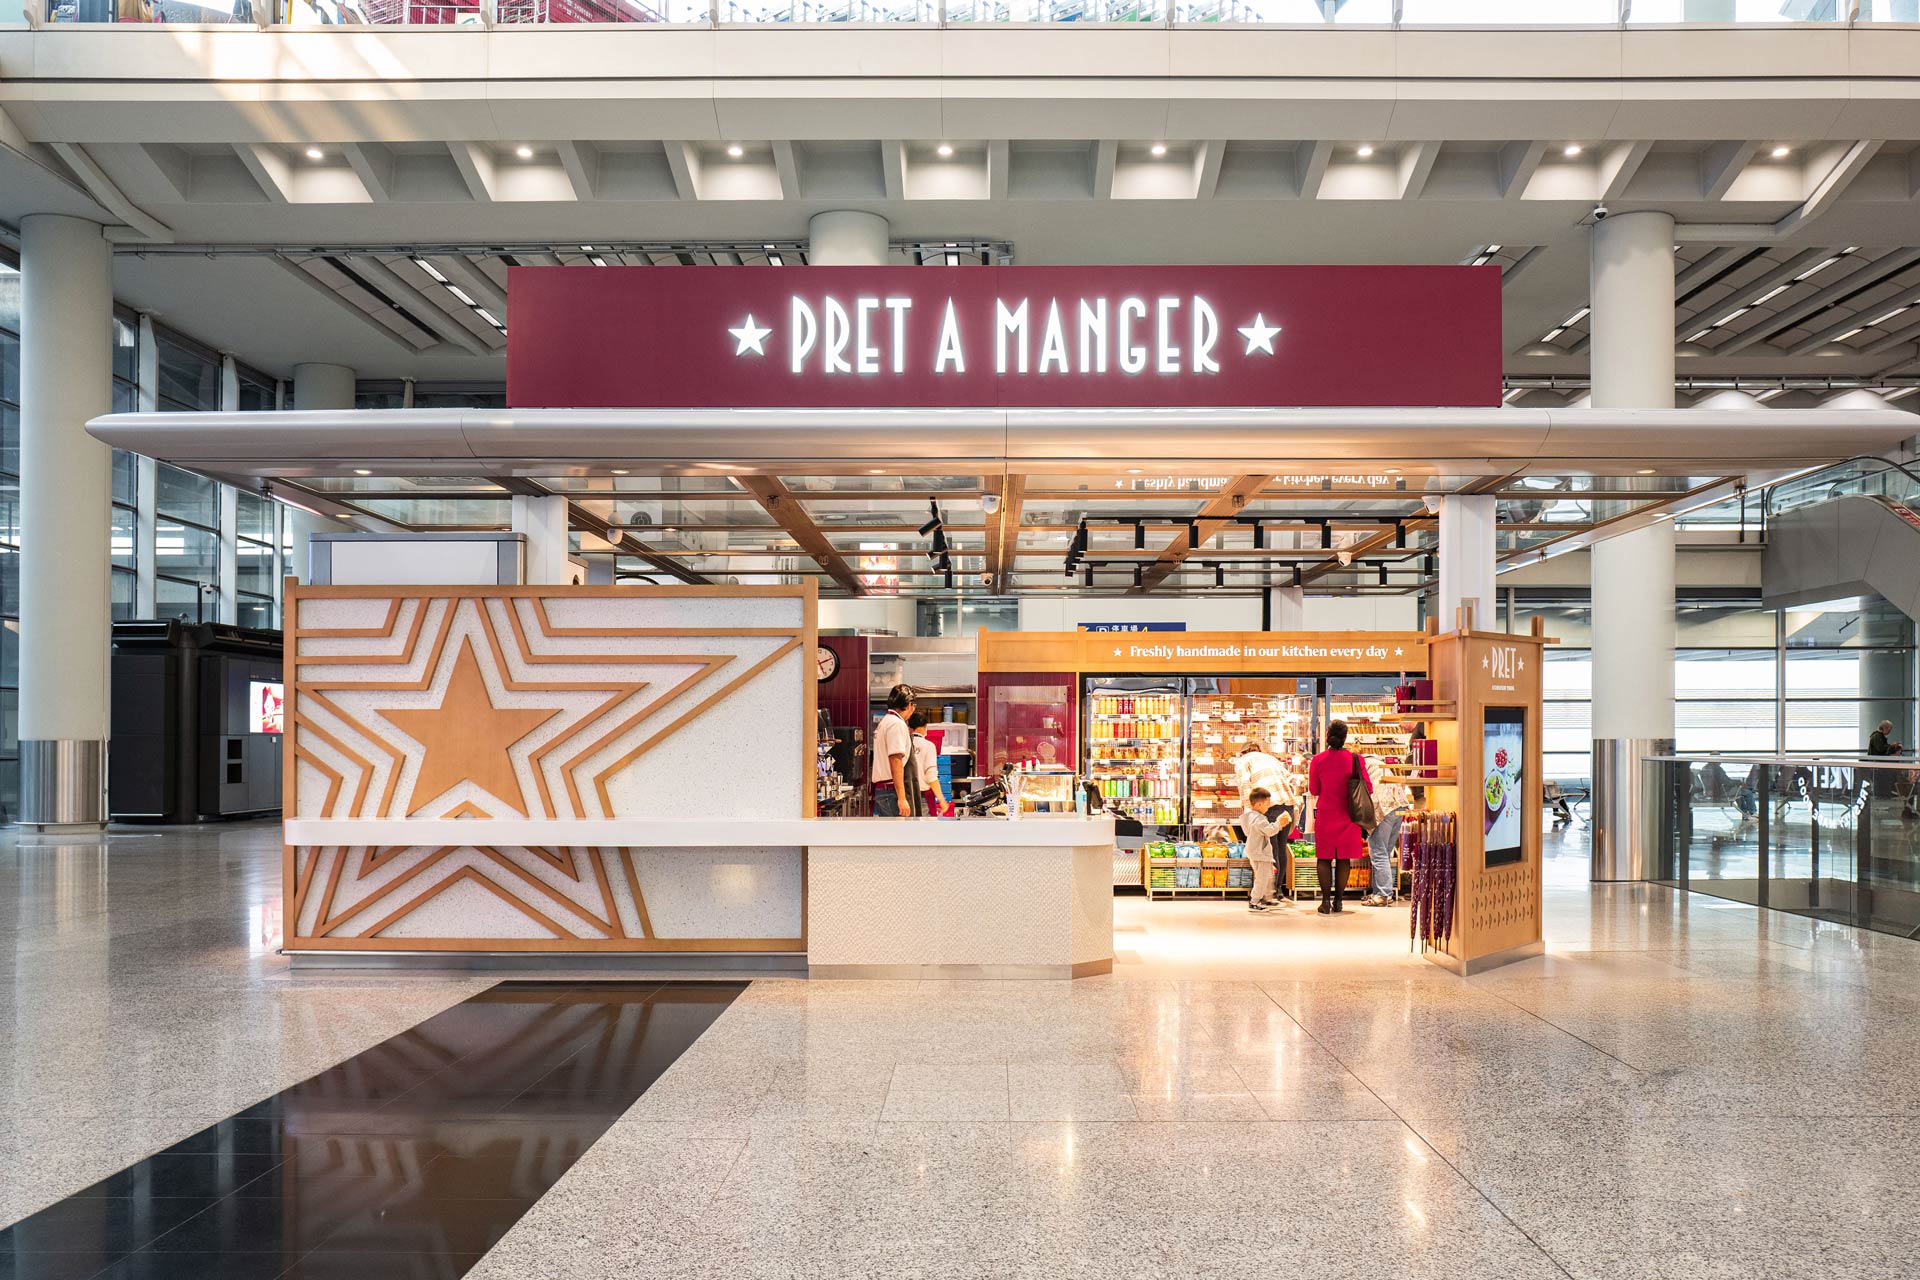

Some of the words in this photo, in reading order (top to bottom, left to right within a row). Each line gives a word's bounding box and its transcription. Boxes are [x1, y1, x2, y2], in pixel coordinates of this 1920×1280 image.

[792, 296, 912, 373] PRET
[935, 297, 965, 373] A
[997, 296, 1220, 373] MANGER
[1130, 645, 1174, 660] Freshly
[1176, 645, 1241, 657] handmade
[1243, 646, 1256, 657] in
[1258, 648, 1280, 657] our
[1281, 645, 1327, 657] kitchen
[1329, 648, 1364, 660] every
[1366, 645, 1389, 660] day
[1492, 646, 1517, 679] PRET
